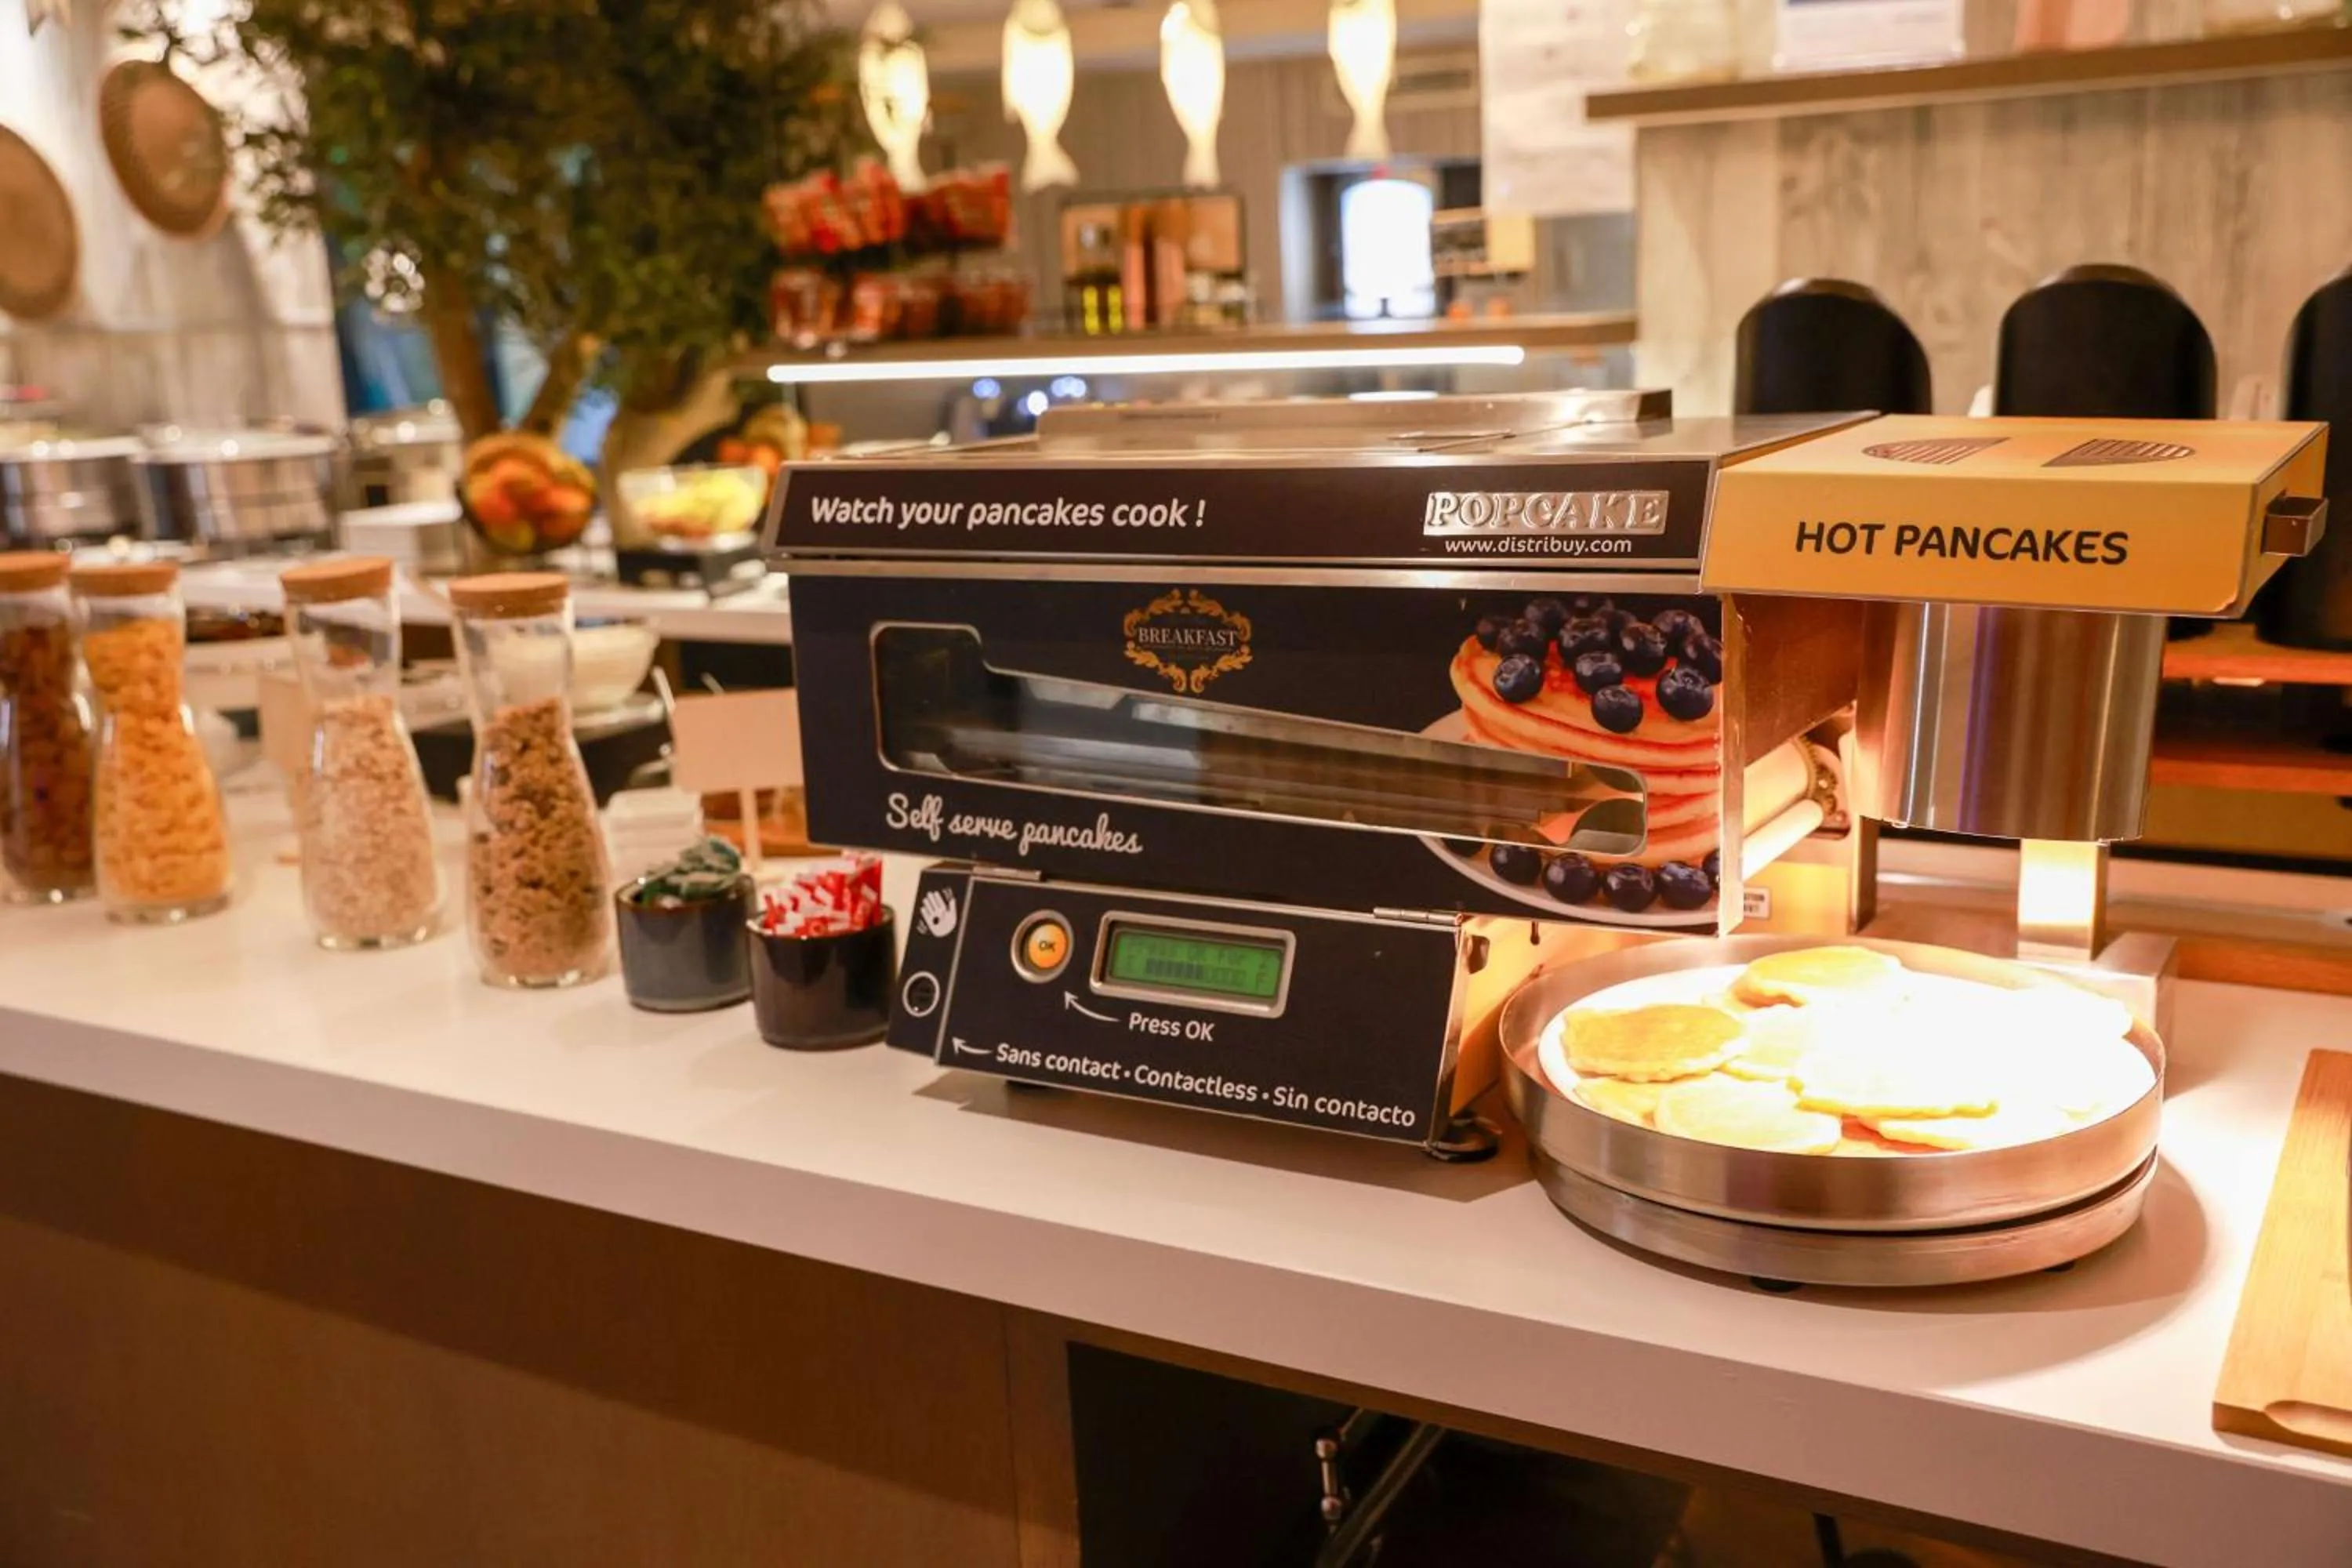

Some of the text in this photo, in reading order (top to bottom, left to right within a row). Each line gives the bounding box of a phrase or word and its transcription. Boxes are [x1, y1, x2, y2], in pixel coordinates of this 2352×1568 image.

[811, 496, 893, 524] Watch
[898, 501, 964, 530] your
[967, 497, 1105, 531] pancakes
[1112, 499, 1188, 528] cook
[1427, 492, 1664, 530] POPCAKE
[1444, 536, 1632, 556] www.distribuy.com
[1795, 521, 2129, 565] HOT PANCAKES
[1138, 626, 1238, 647] BREAKFAST
[886, 792, 1144, 856] Self serve pancakes
[1039, 940, 1056, 953] OK
[1128, 1011, 1215, 1042] Press OK
[996, 1043, 1416, 1127] Sans contact Contactless Sin contacto
